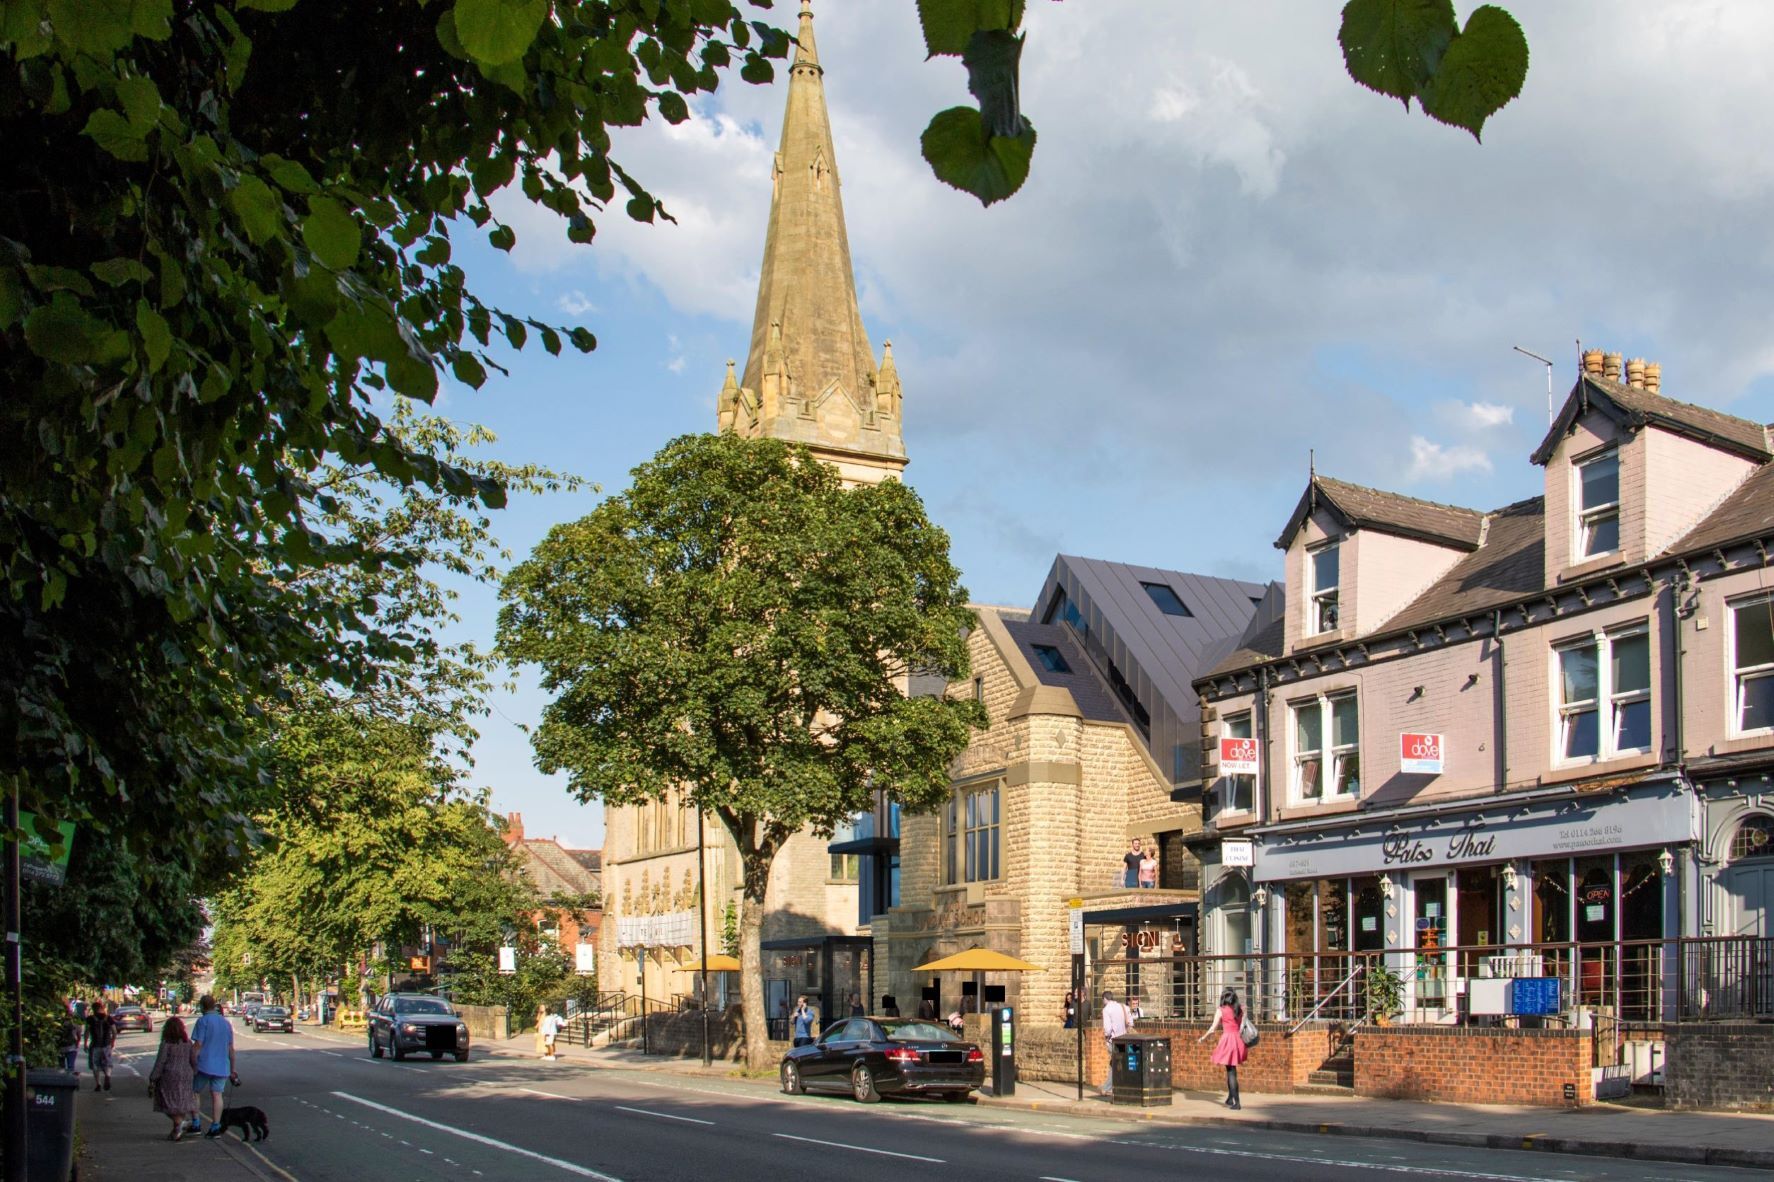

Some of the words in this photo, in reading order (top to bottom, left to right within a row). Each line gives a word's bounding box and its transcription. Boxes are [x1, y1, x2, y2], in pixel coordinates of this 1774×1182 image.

[1230, 742, 1256, 759] dove
[1411, 737, 1439, 757] dove
[1446, 823, 1496, 859] Thai
[1587, 888, 1611, 900] OPEN
[954, 909, 986, 928] SCHOO
[35, 1094, 56, 1106] 544
